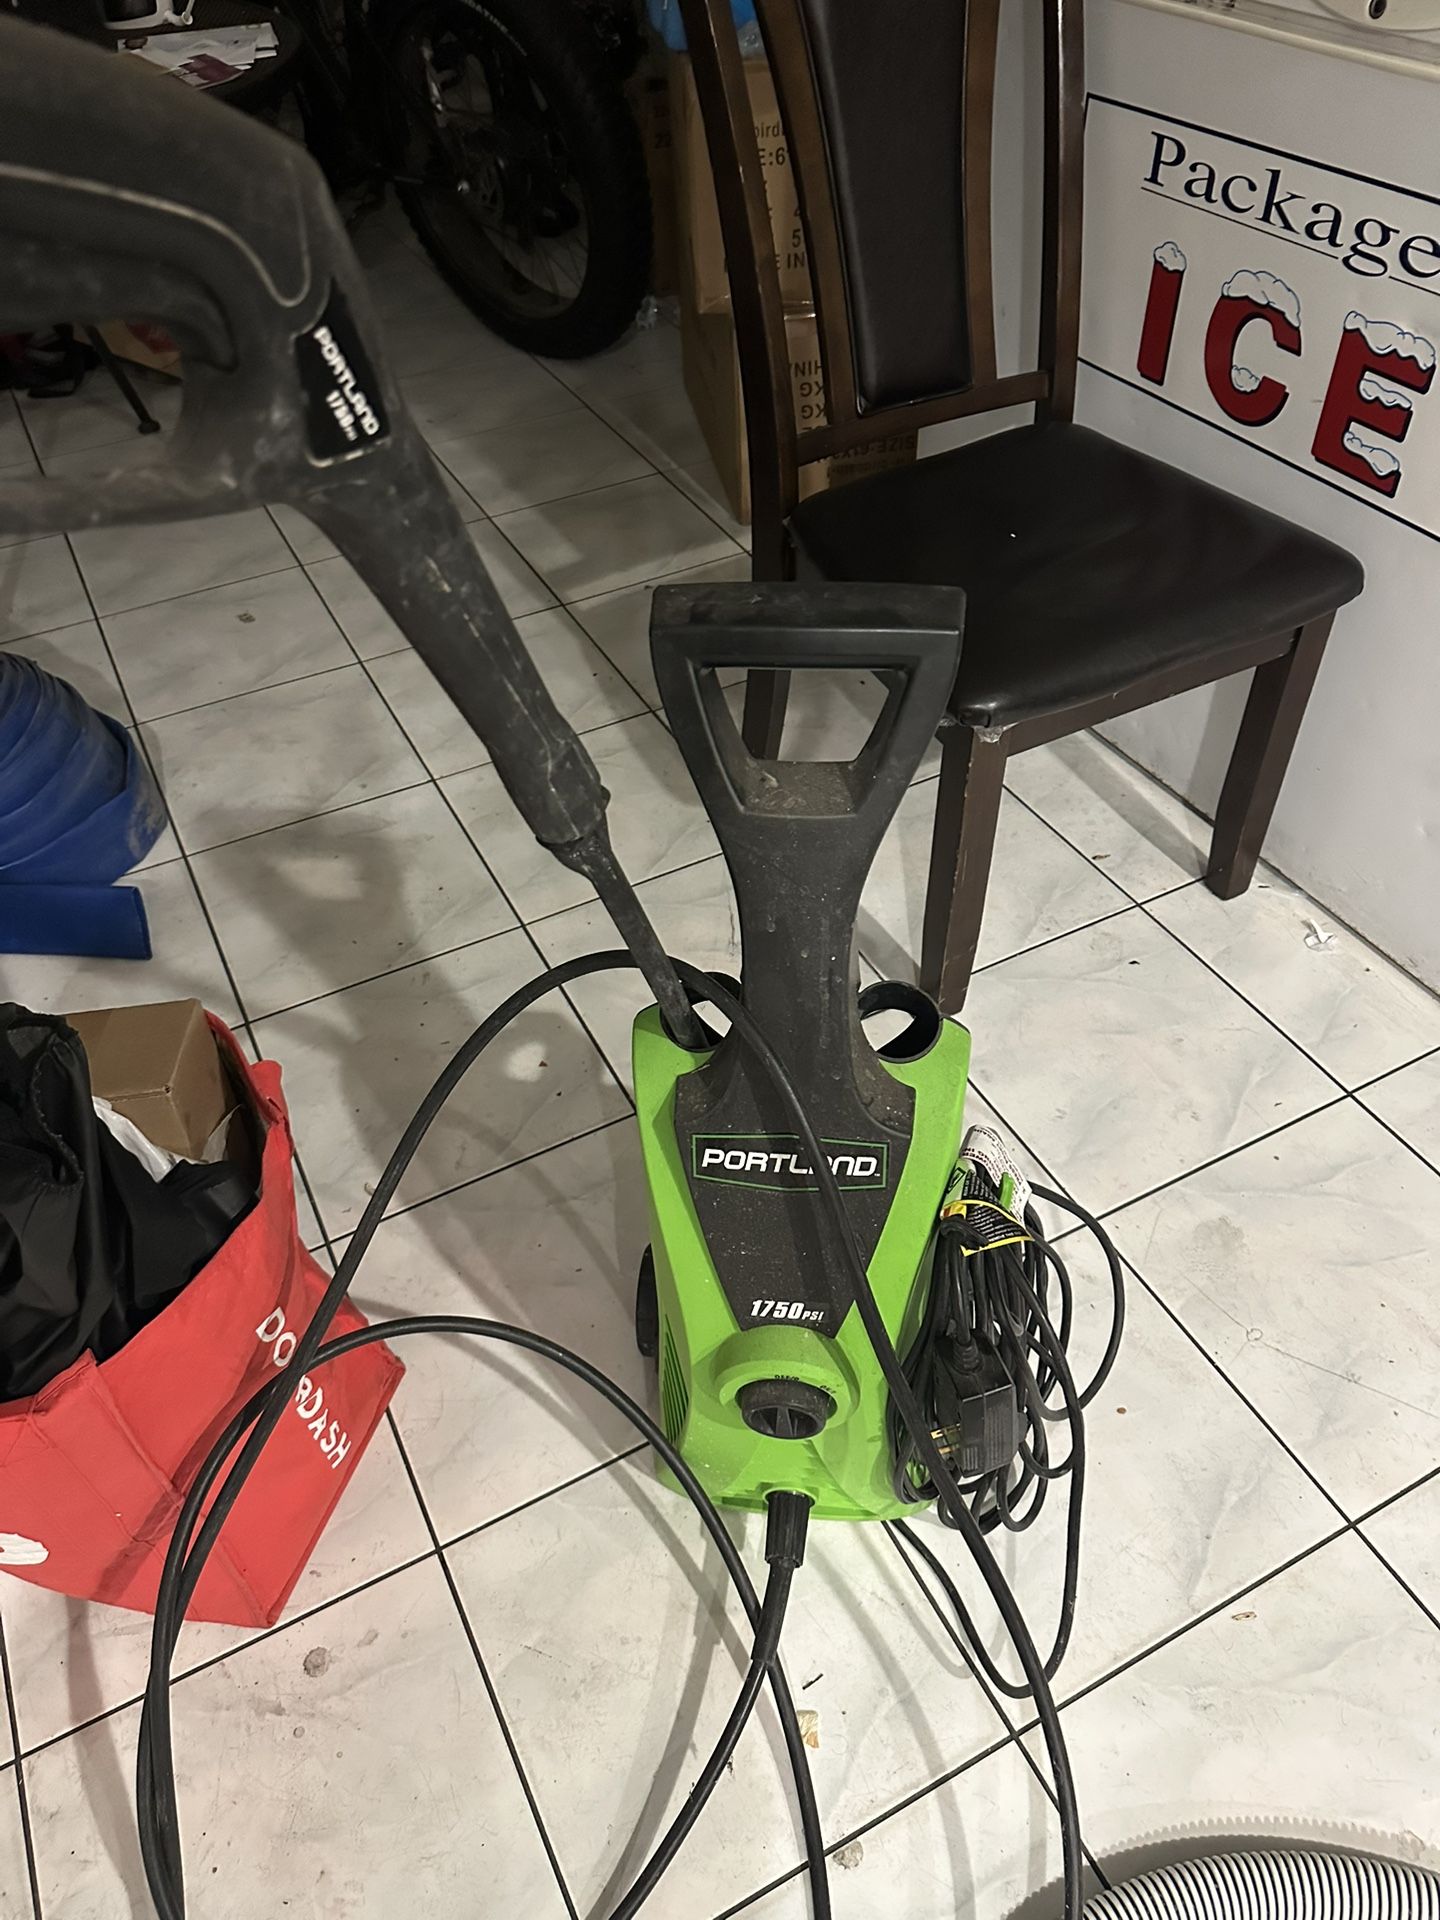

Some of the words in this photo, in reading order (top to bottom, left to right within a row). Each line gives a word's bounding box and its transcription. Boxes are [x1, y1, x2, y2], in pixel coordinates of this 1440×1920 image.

[1143, 131, 1440, 278] Package
[313, 326, 379, 436] PORTLAND
[1137, 241, 1436, 499] ICE
[256, 1306, 351, 1469] DORDASH
